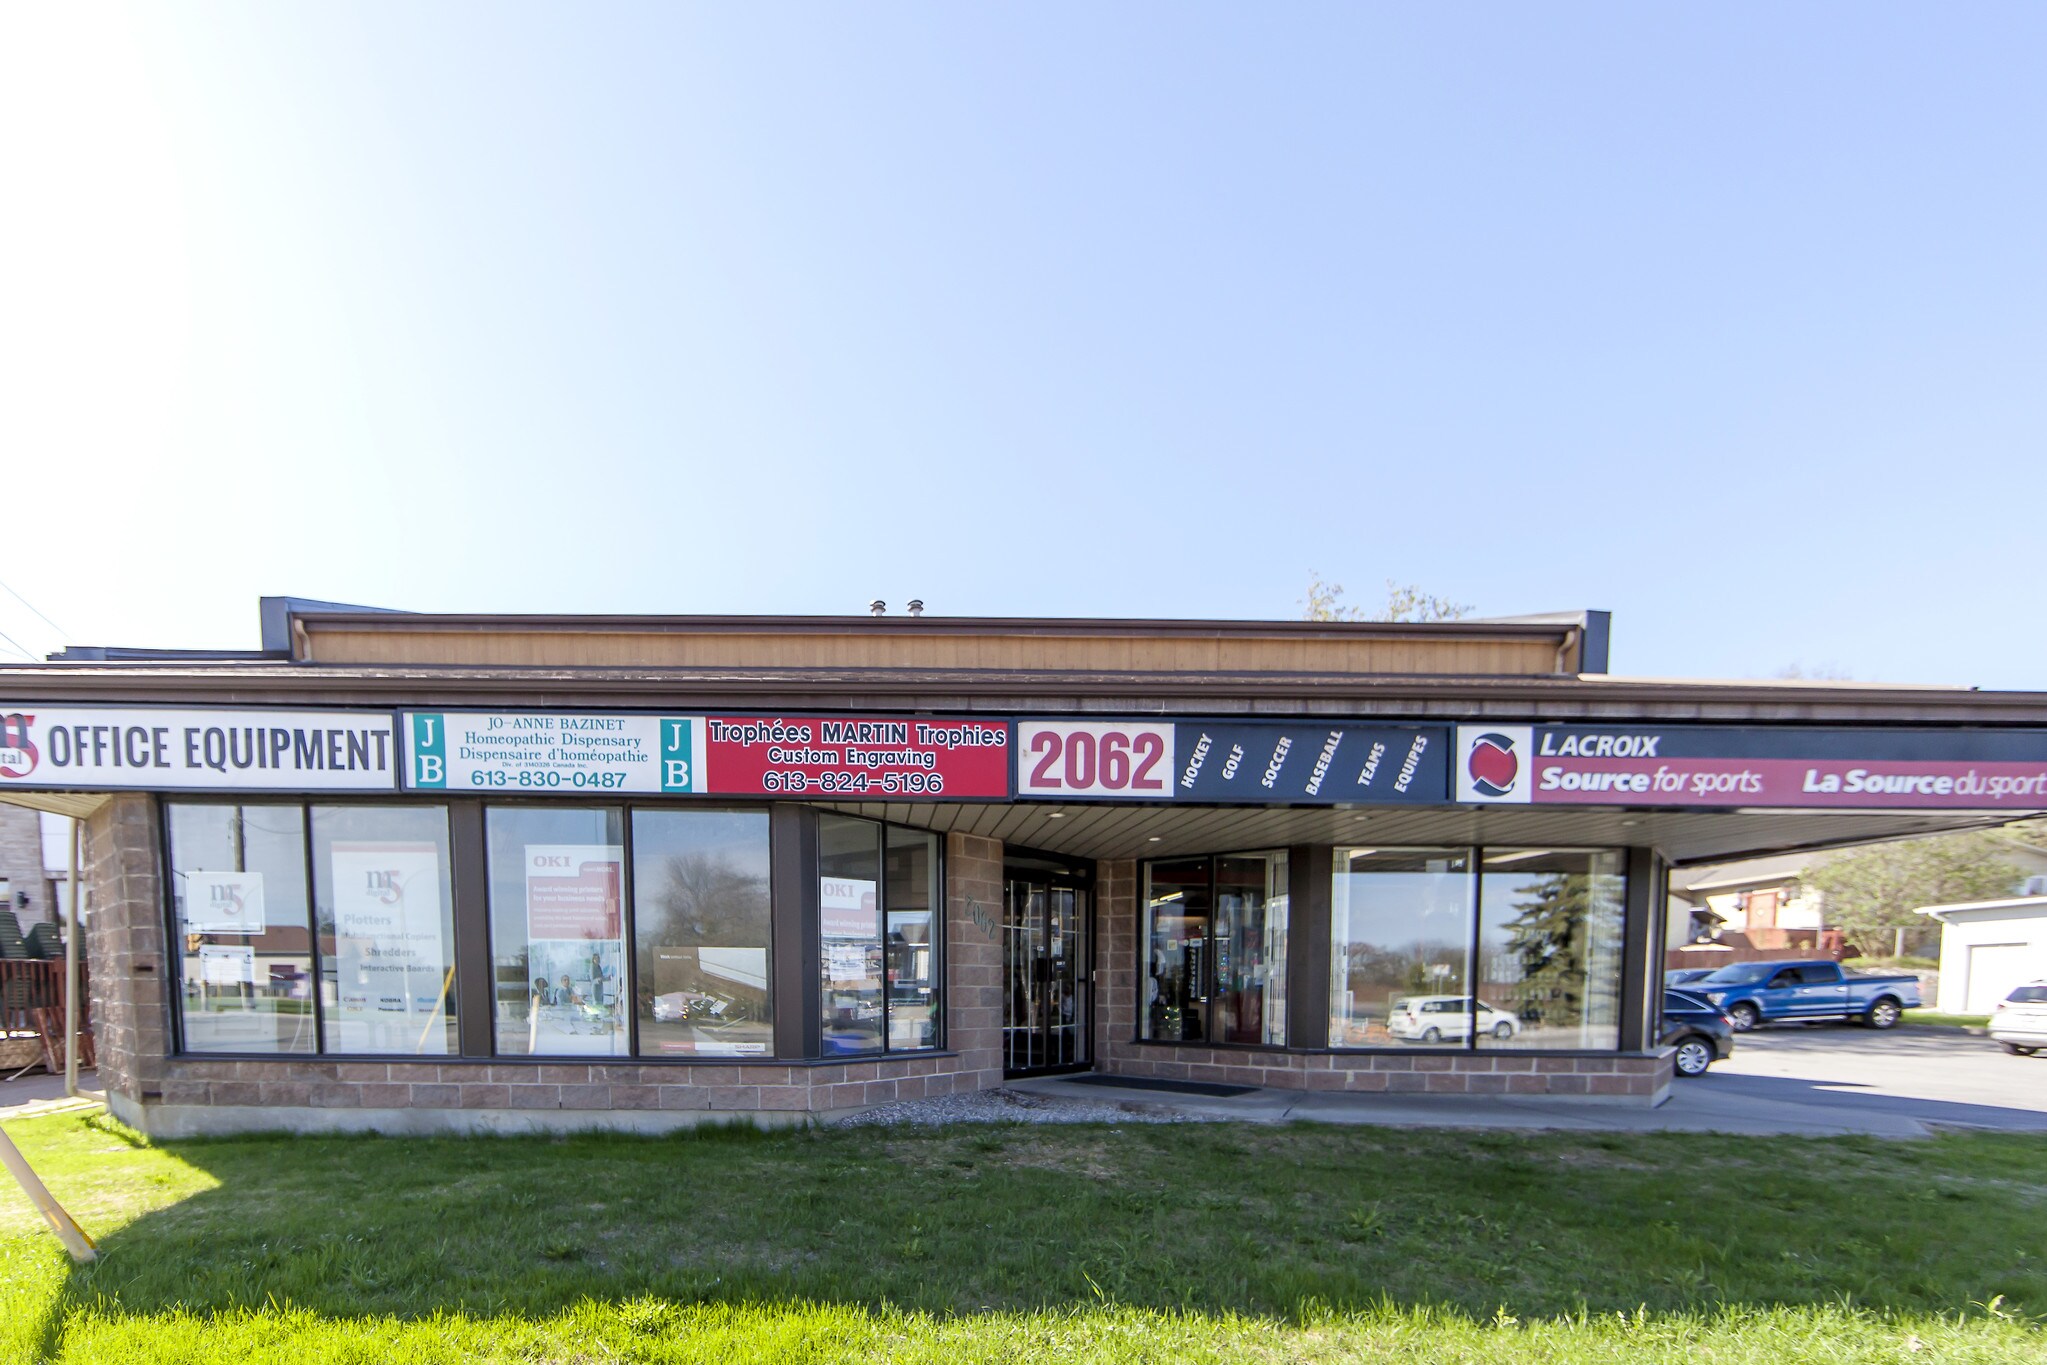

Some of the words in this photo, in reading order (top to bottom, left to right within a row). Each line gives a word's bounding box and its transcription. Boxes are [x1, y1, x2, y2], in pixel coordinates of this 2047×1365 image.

[487, 716, 554, 731] JO-ANNE
[559, 718, 625, 732] BAZINET
[709, 718, 812, 748] Trophées
[821, 722, 908, 745] MARTIN
[916, 724, 1006, 749] Trophies
[48, 724, 171, 768] OFFICE
[184, 727, 391, 774] EQUIPMENT
[465, 731, 555, 748] Homeopathic
[561, 733, 642, 750] Dispensary
[1539, 732, 1662, 758] LACROIX
[459, 747, 542, 763] Dispensaire
[547, 748, 649, 764] d'homéopathie
[767, 747, 839, 766] Custom
[845, 747, 936, 770] Engraving
[1029, 731, 1165, 790] 2062
[1180, 733, 1213, 790] HOCKEY
[1220, 743, 1246, 781] GOLF
[1261, 735, 1293, 790] SOCCER
[1304, 730, 1344, 797] BASEBALL
[1356, 741, 1386, 787] TEAMS
[1393, 734, 1428, 794] EQUIPES
[470, 770, 628, 789] 613-830-0487
[762, 770, 944, 793] 613-824-5196
[1538, 766, 1650, 792] Source
[1652, 765, 1690, 793] for
[1689, 769, 1763, 797] sports
[1802, 768, 1841, 793] La
[1842, 768, 1953, 795] Source
[1954, 769, 1985, 795] du
[1985, 772, 2047, 800] sport
[533, 855, 572, 868] OKI
[823, 882, 855, 898] OKI
[343, 913, 392, 926] Plotters
[965, 894, 996, 940] 2062
[405, 932, 437, 942] Copiers
[365, 947, 416, 957] Shredders
[360, 963, 404, 973] Interactive
[405, 964, 435, 974] Boards
